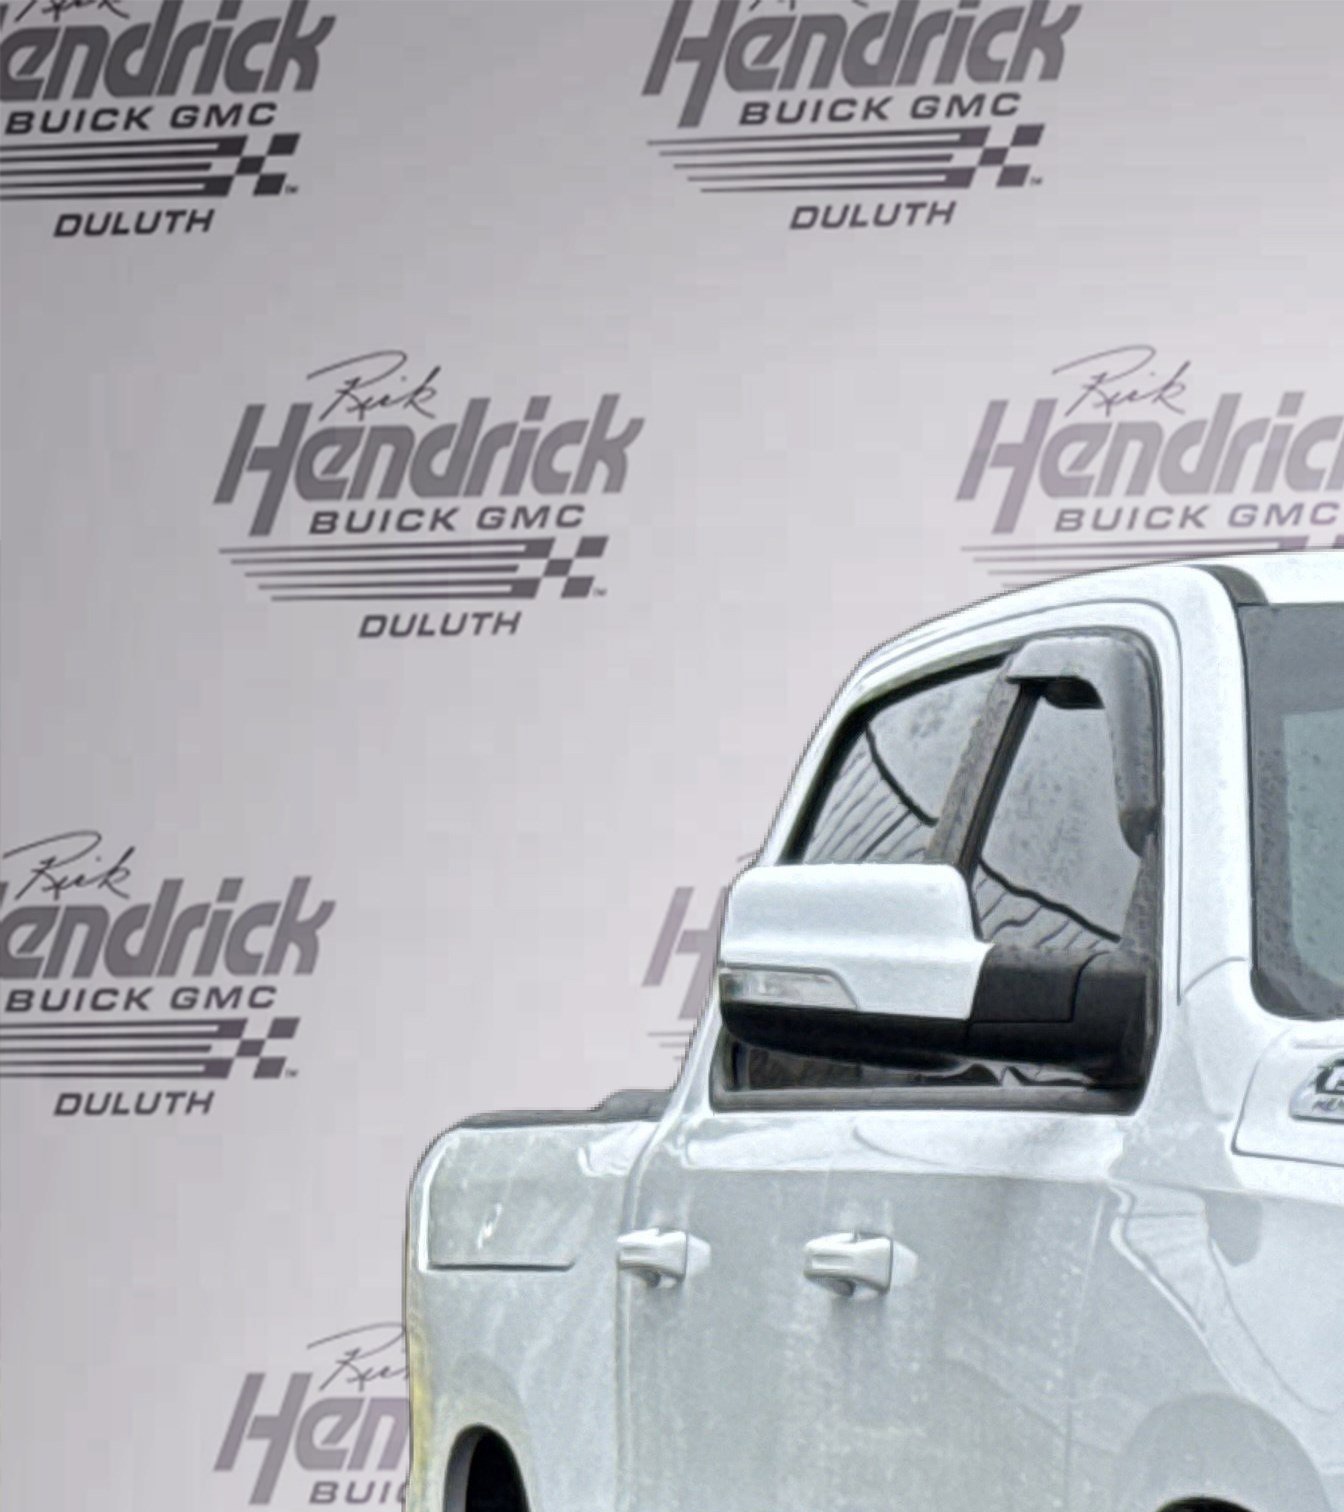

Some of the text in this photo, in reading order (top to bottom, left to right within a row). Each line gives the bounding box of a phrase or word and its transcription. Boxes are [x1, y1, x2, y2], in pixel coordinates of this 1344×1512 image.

[0, 0, 336, 100] endrick
[641, 0, 1082, 128] Hendrick
[5, 102, 278, 134] BUICK GMC
[739, 92, 1022, 126] BUICK GMC
[53, 209, 215, 238] DULUTH
[789, 200, 957, 230] DULUTH
[212, 393, 645, 537] Hendrick
[308, 504, 586, 535] BUICK GMC
[1054, 501, 1341, 533] BUICK GMC
[358, 610, 522, 639] DULUTH
[0, 875, 336, 980] endrick
[4, 985, 278, 1012] BUICK GMC
[53, 1090, 215, 1116] DULUTH
[308, 1481, 406, 1505] BUI
